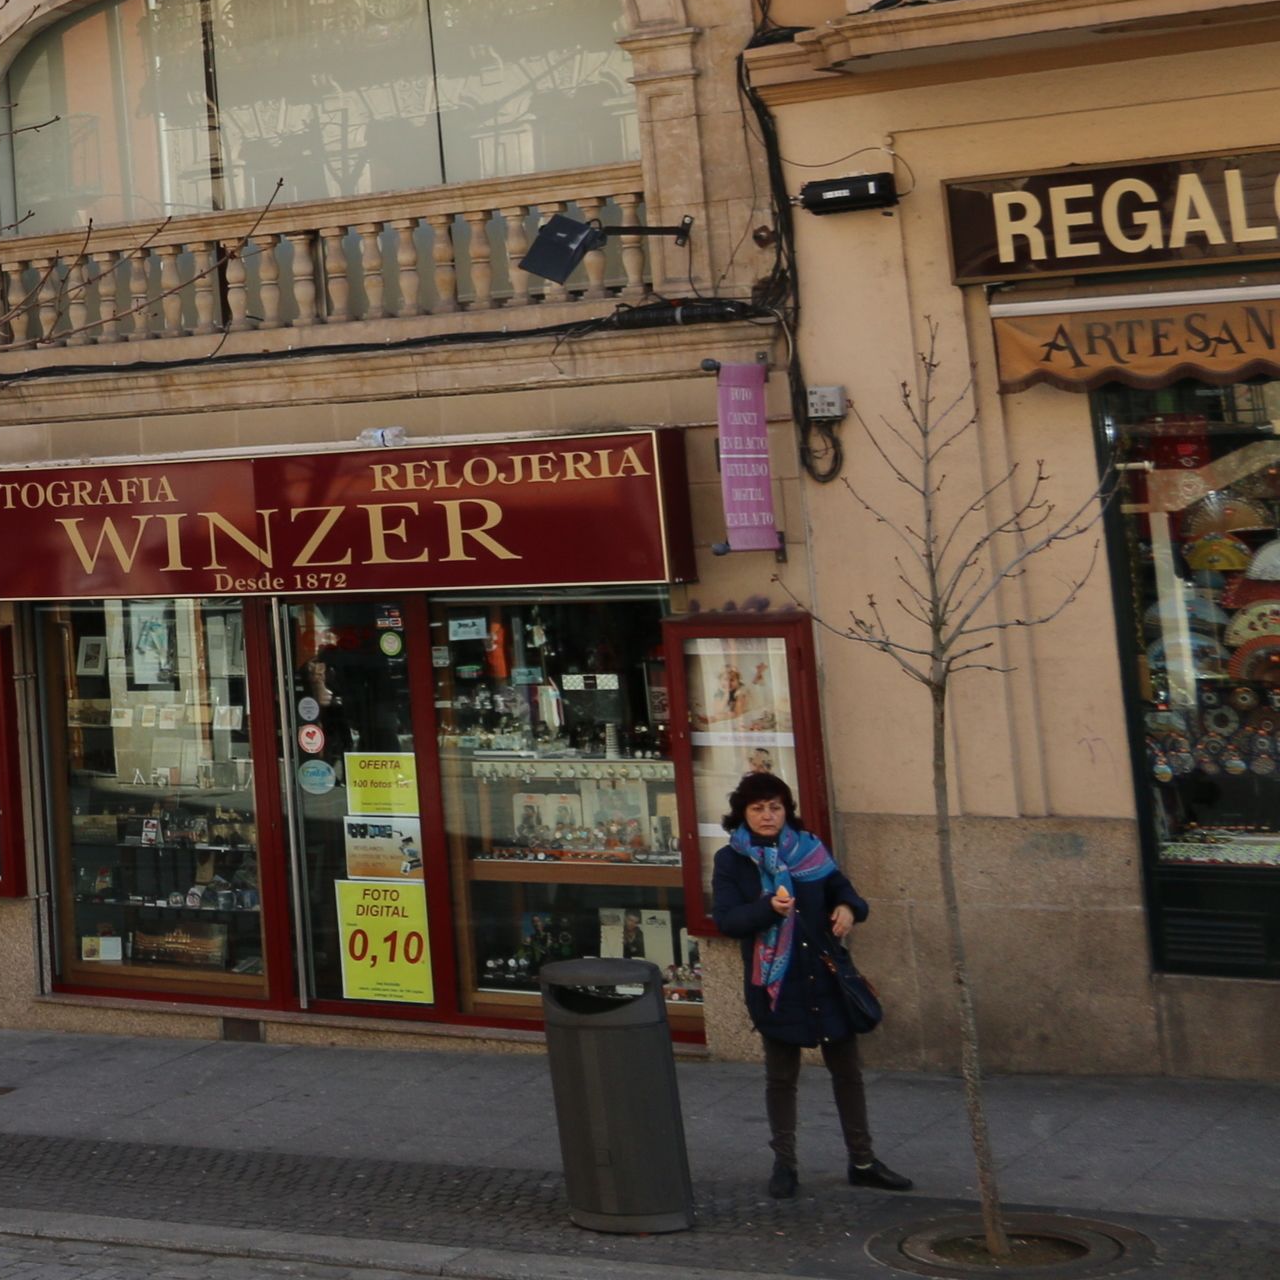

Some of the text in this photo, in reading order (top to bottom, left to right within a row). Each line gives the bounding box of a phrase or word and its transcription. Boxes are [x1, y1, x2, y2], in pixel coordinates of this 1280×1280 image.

[992, 169, 1280, 263] REGAL
[370, 445, 652, 493] RELOJERIA
[54, 498, 523, 575] WINZER
[214, 572, 348, 592] Desde 1872
[359, 760, 401, 770] OFERTA
[353, 780, 368, 788] 100
[370, 780, 392, 789] fotos
[362, 889, 400, 902] FOTO
[355, 904, 409, 918] DIGITAL
[348, 928, 424, 968] 0,10
